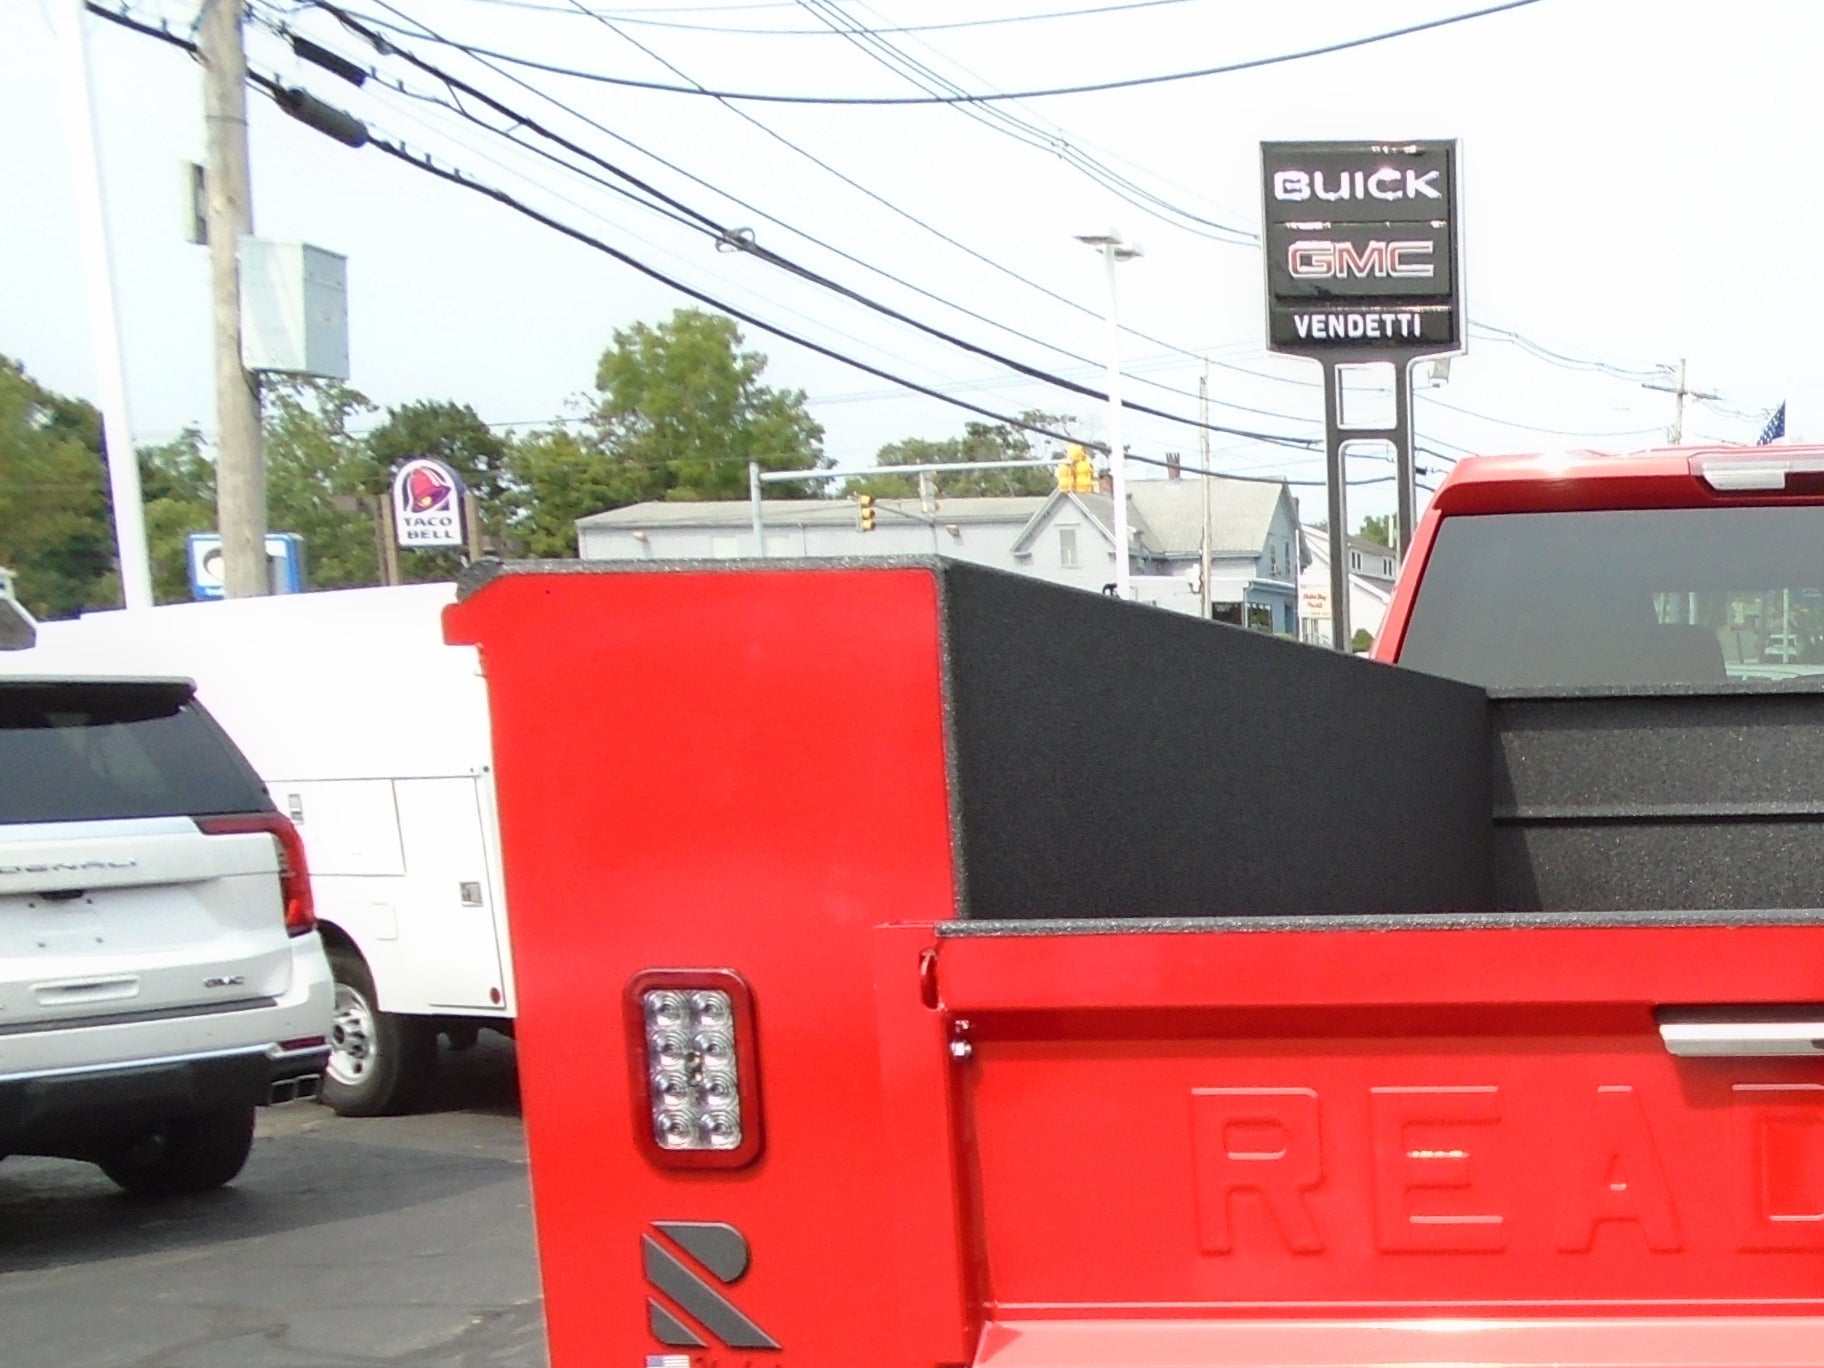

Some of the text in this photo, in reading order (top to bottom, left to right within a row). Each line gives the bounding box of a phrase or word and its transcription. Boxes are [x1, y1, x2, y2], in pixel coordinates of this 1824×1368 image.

[1273, 168, 1442, 201] BUICK
[1288, 240, 1434, 279] GMC
[1294, 313, 1421, 339] VENDETTI
[404, 516, 452, 527] TACO
[407, 530, 454, 539] BELL
